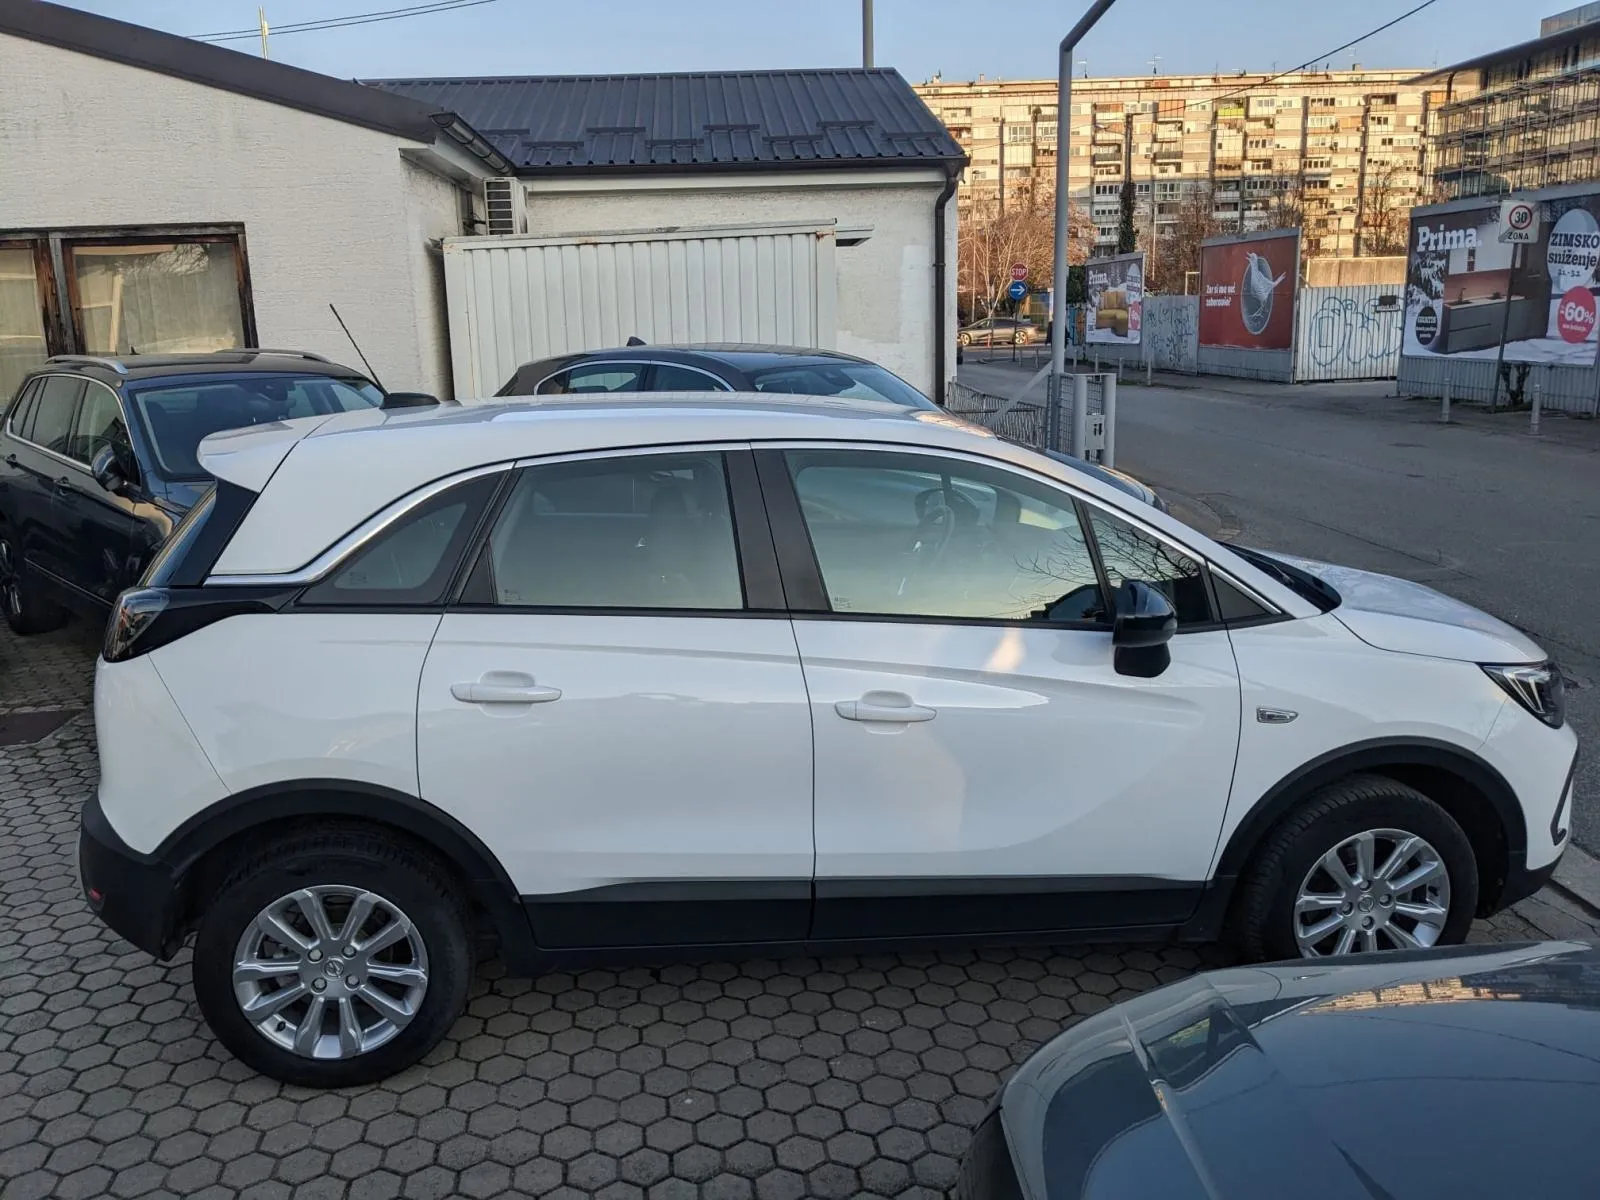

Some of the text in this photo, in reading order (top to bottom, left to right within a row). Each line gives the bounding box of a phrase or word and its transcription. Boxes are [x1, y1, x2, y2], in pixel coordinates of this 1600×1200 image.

[1514, 211, 1528, 224] 30
[1507, 231, 1529, 240] ZONA
[1550, 232, 1600, 249] ZIMSKO
[1548, 249, 1597, 270] sniženje
[1011, 268, 1027, 276] STOP
